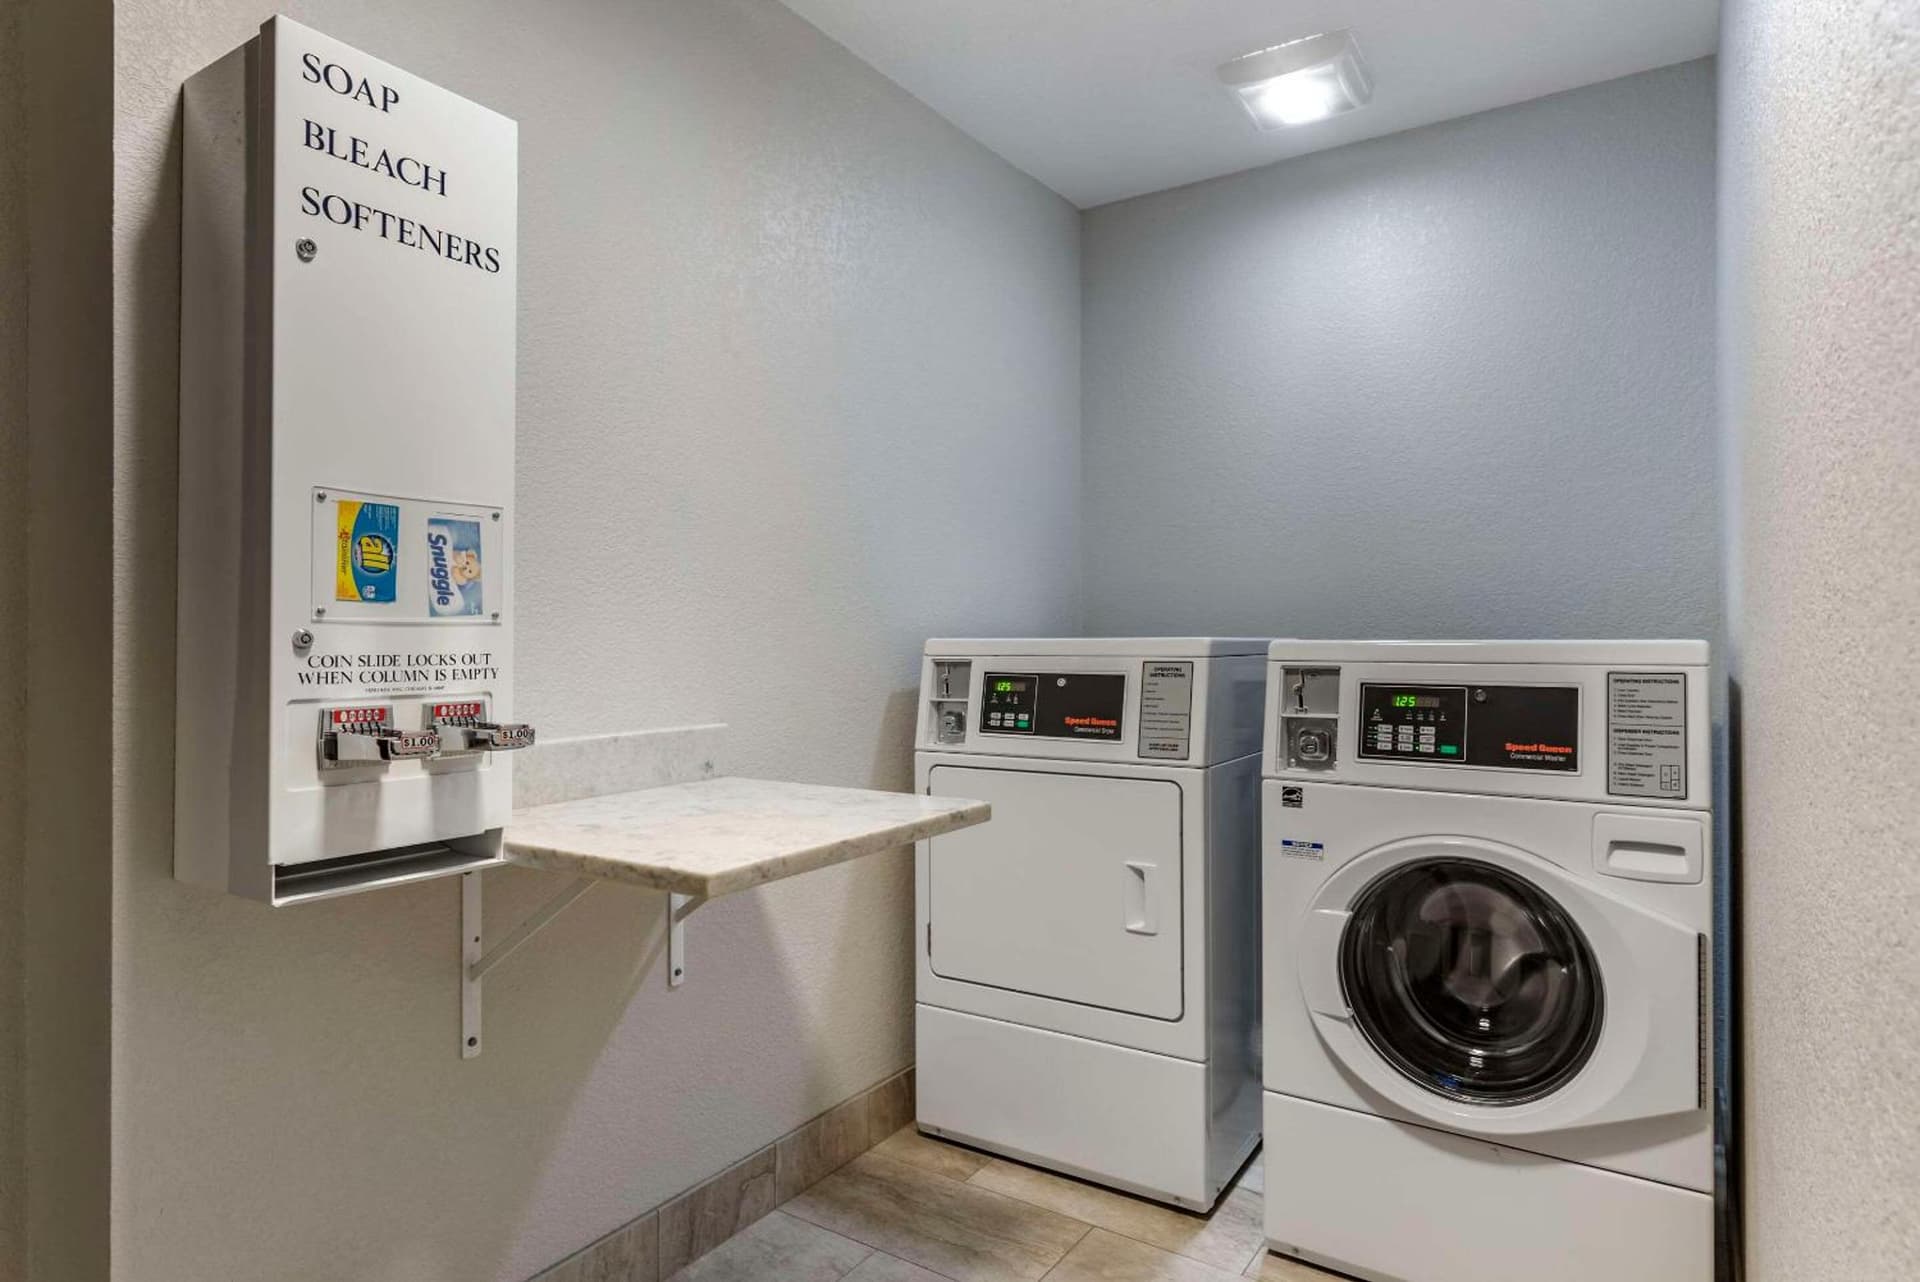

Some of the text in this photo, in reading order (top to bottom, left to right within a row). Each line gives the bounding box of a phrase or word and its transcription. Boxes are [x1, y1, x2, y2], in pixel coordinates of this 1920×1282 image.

[302, 53, 399, 113] SOAP
[303, 118, 448, 197] BLEACH
[301, 186, 500, 273] SOFTENERS
[360, 536, 390, 570] all
[428, 532, 455, 606] Snuggle
[298, 667, 499, 686] WHEN COLUMN IS EMPTY
[307, 652, 491, 669] COIN SLIDE LOCKS OUT
[403, 737, 434, 748] $1.00
[502, 729, 528, 740] $1.00
